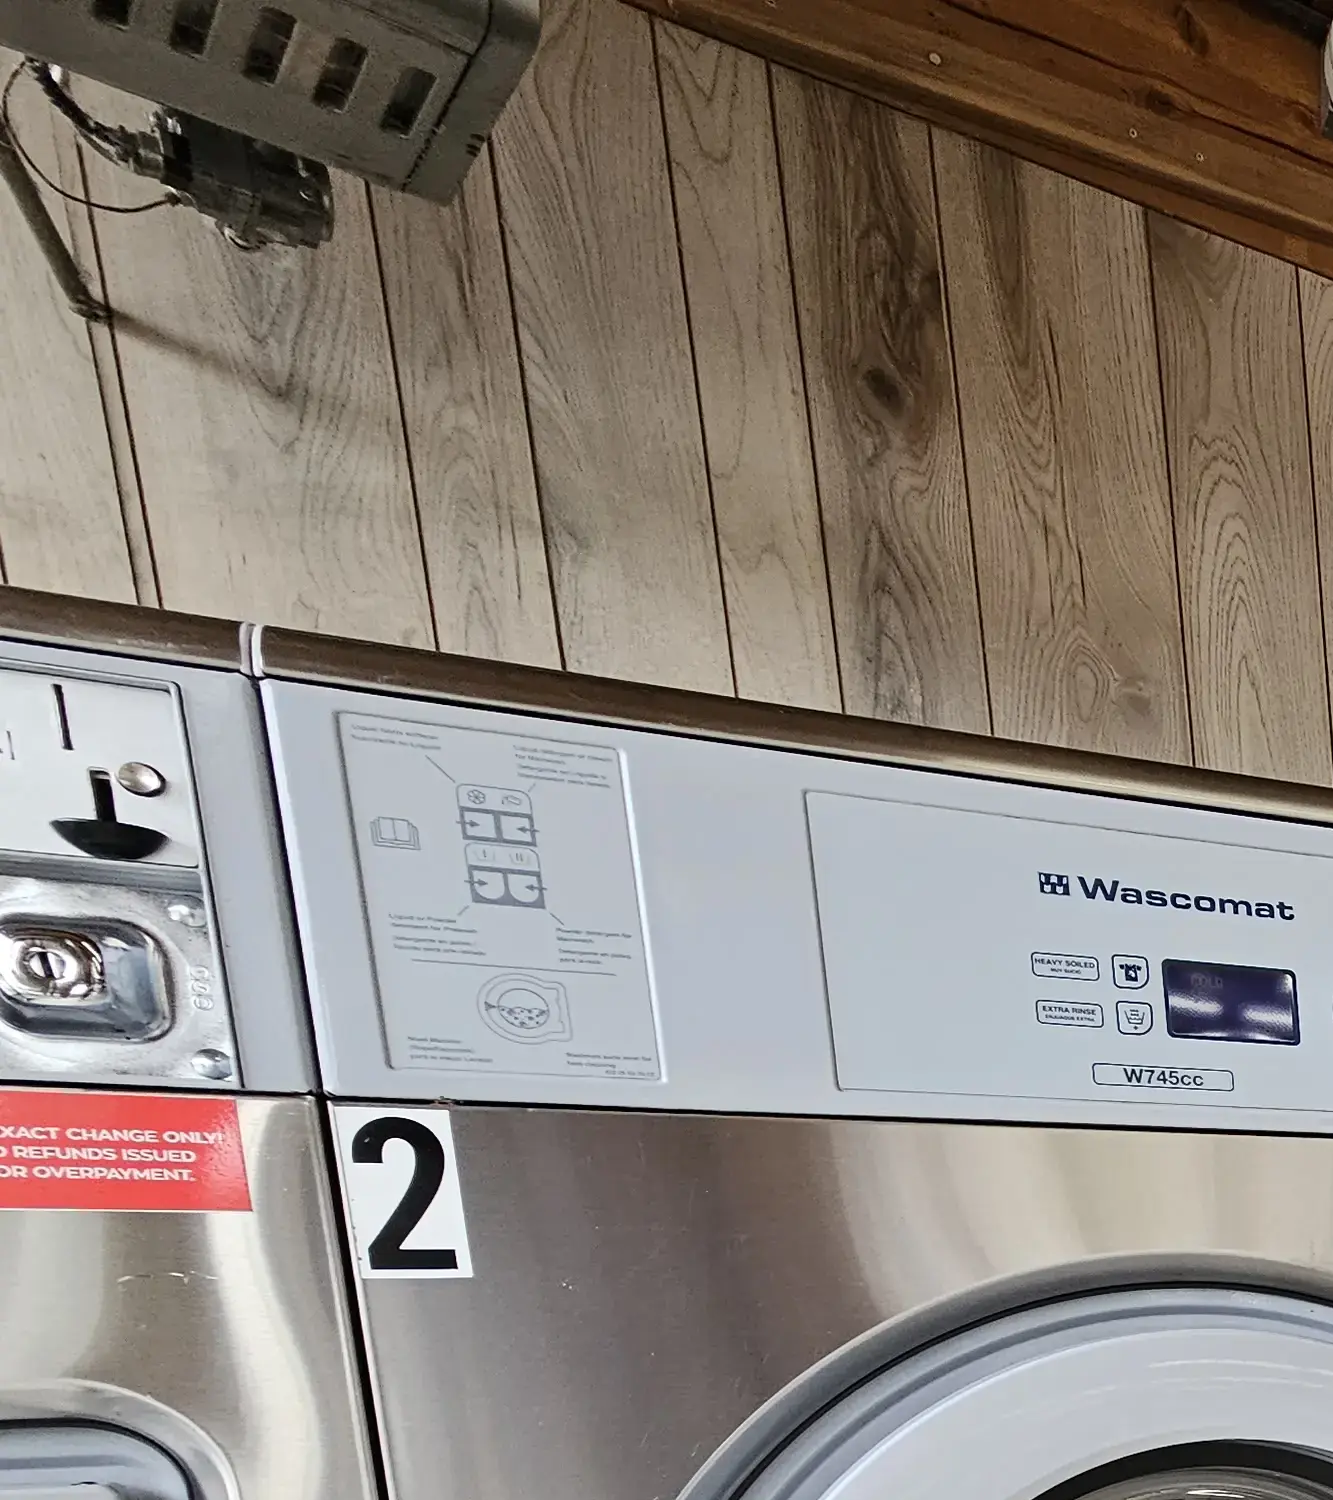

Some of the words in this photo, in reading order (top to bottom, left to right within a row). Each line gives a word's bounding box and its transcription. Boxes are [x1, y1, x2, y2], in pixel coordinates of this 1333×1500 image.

[1077, 876, 1295, 921] Wascomat
[1034, 956, 1063, 967] HEAVY
[1065, 958, 1096, 969] SOILED
[1042, 1005, 1070, 1015] EXTRA
[1071, 1007, 1097, 1016] RINSE
[1123, 1067, 1204, 1087] W745cc
[0, 1125, 60, 1140] XACT
[66, 1127, 159, 1143] CHANGE
[162, 1130, 225, 1145] ONLY!
[12, 1145, 118, 1161] REFUNDS
[122, 1148, 197, 1163] ISSUED
[0, 1165, 28, 1178] OR
[32, 1166, 197, 1182] OVERPAYMENT.
[351, 1117, 459, 1271] 2
